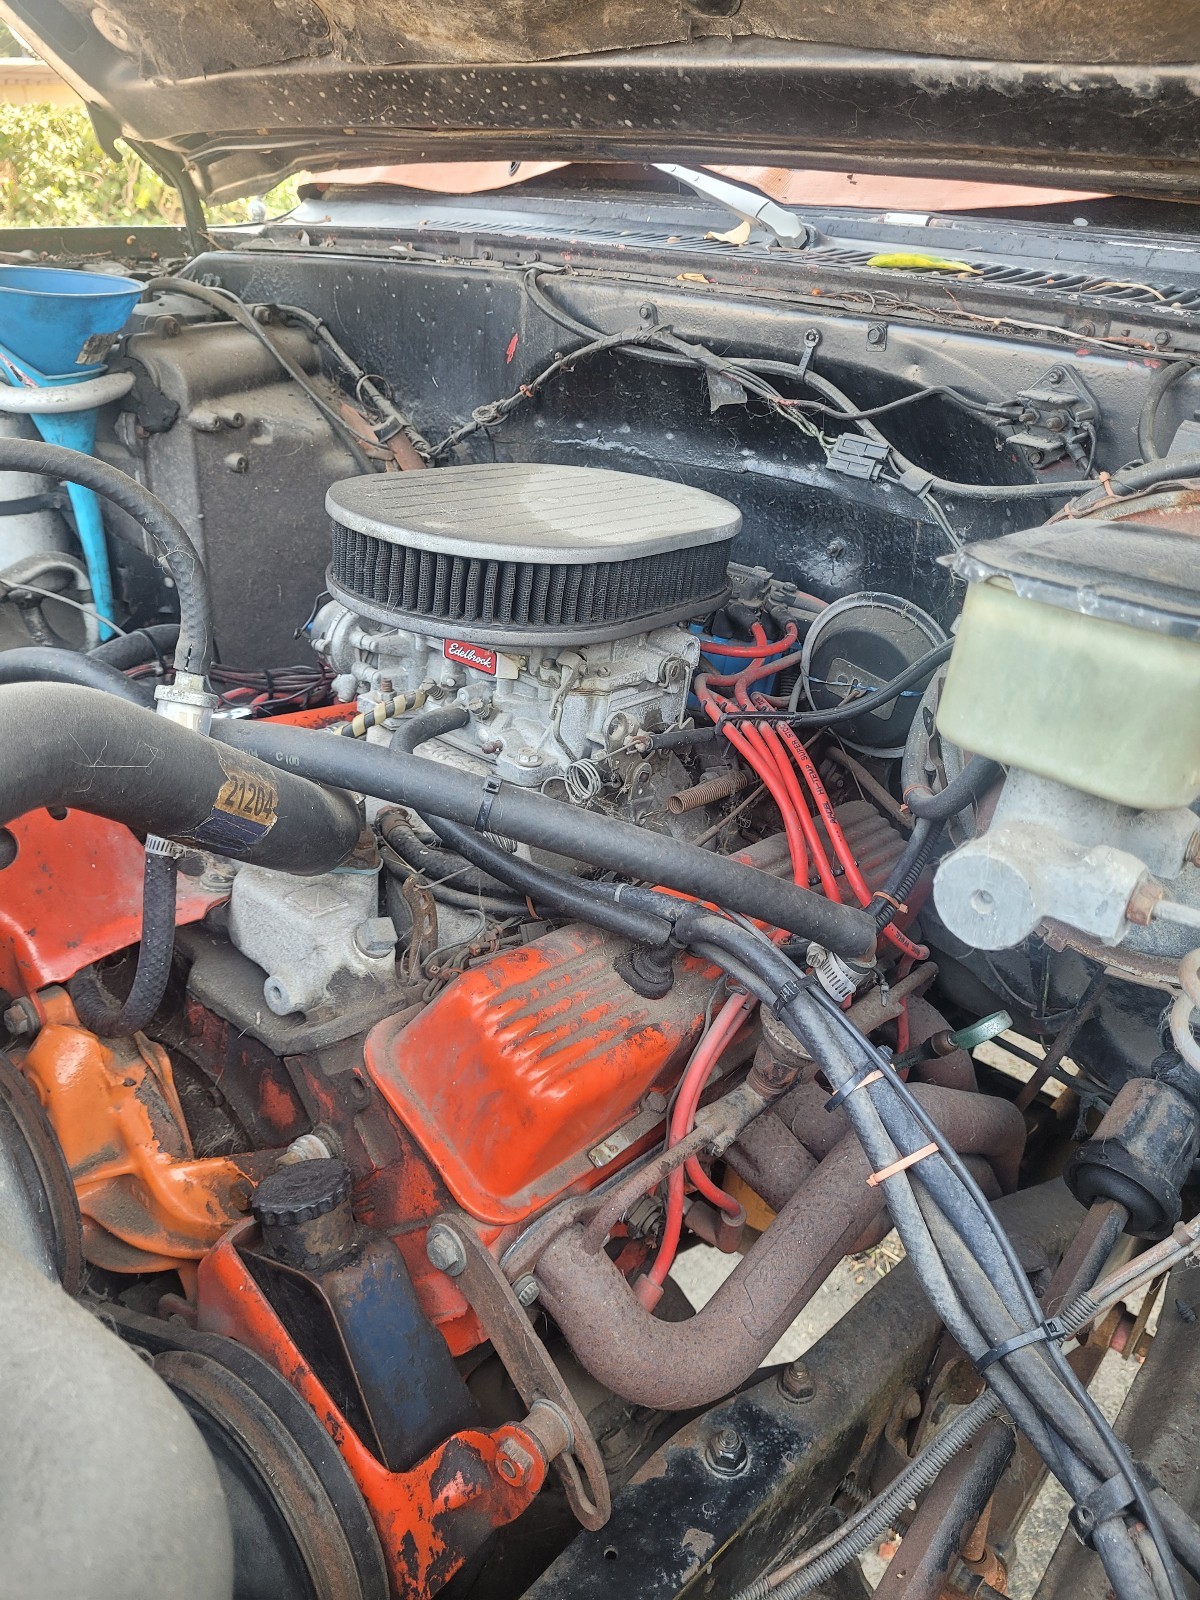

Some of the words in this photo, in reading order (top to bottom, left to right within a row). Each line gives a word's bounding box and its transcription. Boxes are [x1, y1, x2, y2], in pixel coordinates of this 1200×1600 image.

[448, 642, 492, 668] Edelbrock
[791, 739, 808, 761] SUPER
[805, 763, 825, 797] HI-TEMP
[224, 775, 273, 820] 21204
